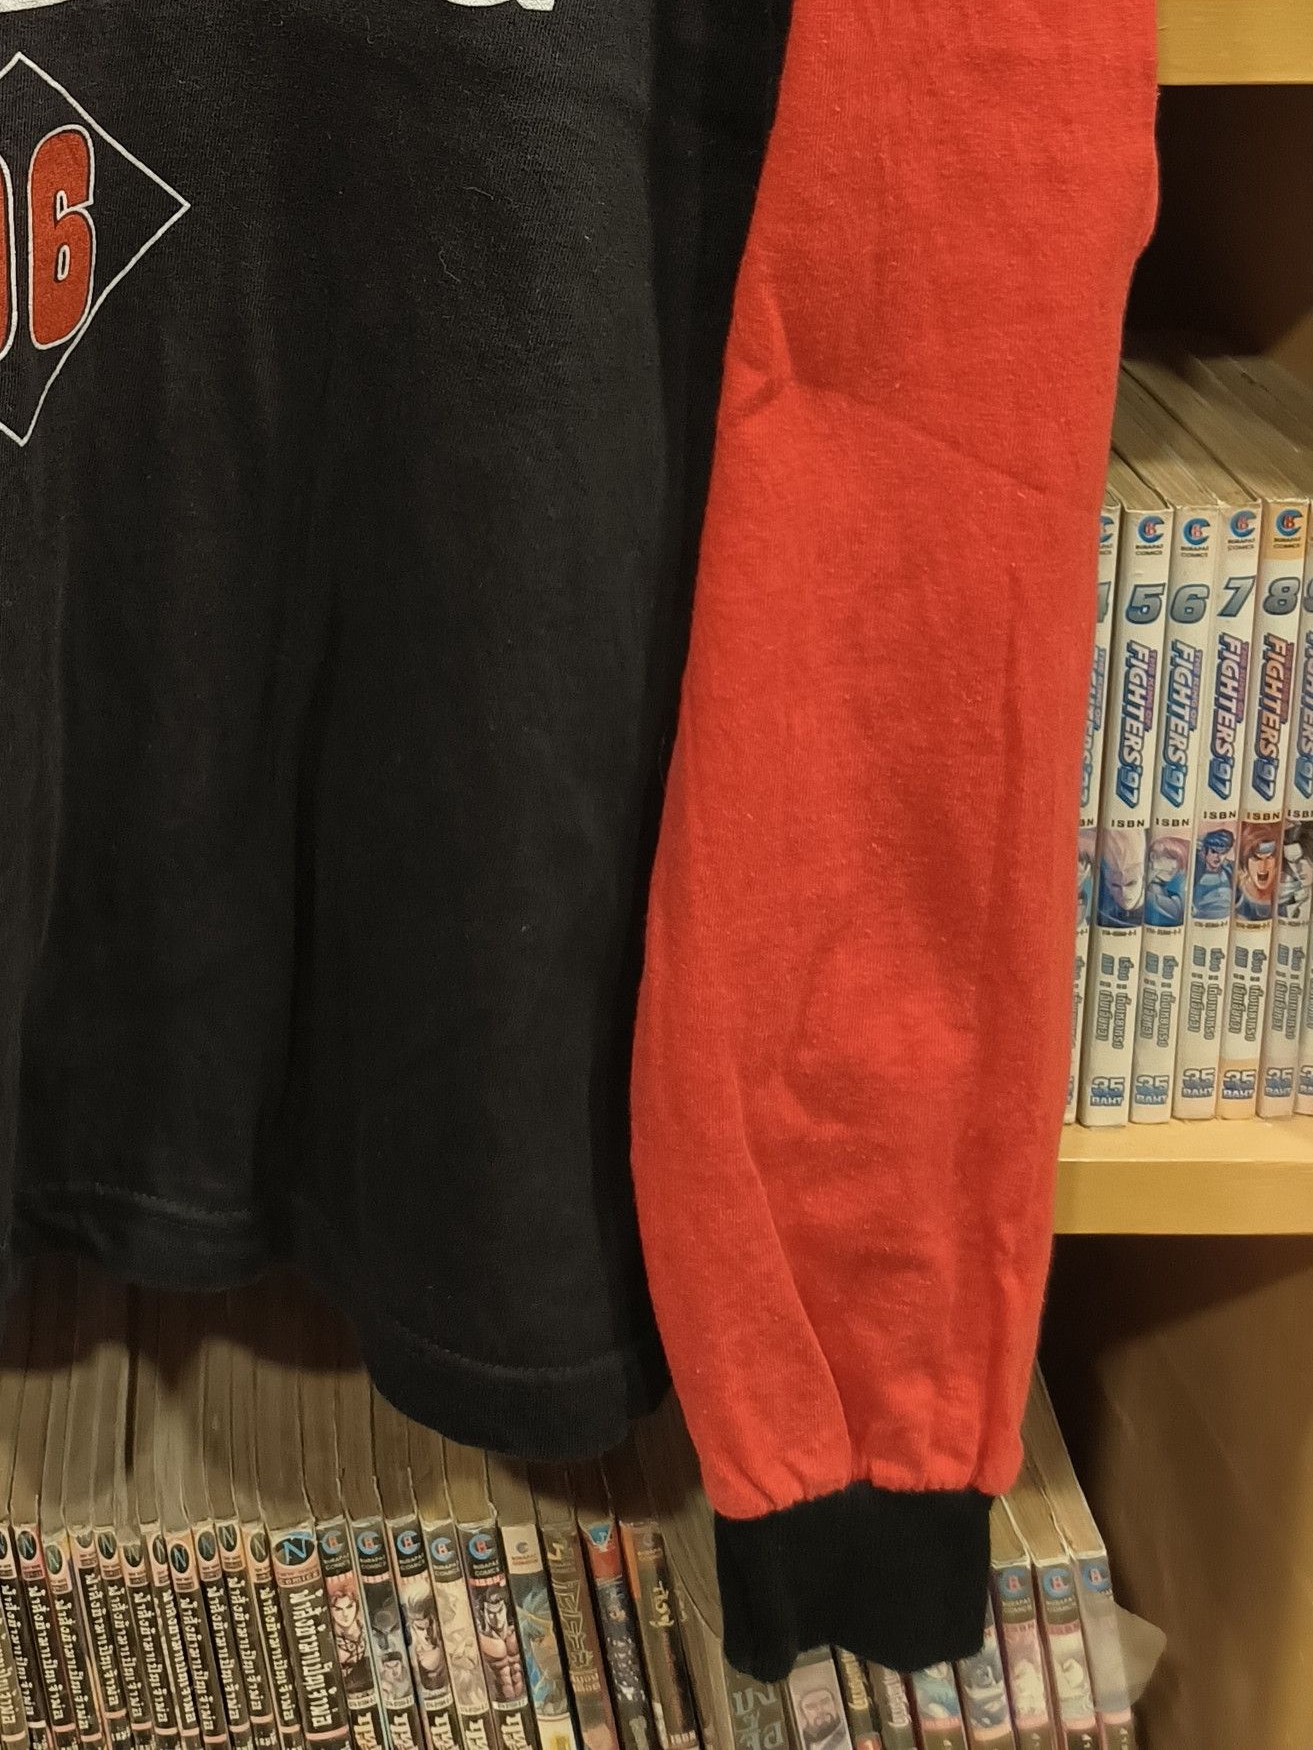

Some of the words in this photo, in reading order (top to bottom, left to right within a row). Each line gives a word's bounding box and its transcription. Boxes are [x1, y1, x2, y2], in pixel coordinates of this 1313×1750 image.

[1125, 583, 1166, 624] 5
[1170, 584, 1210, 624] 6
[1217, 576, 1256, 617] 7
[1263, 577, 1300, 615] 8
[1119, 640, 1152, 761] FIGHTERS
[1163, 639, 1196, 760] FIGHTERS
[1210, 632, 1245, 754] FIGHTERS
[1255, 633, 1289, 754] FIGHTERS
[1111, 819, 1144, 828] ISBN
[1156, 818, 1189, 827] ISBN
[1203, 811, 1236, 820] ISBN
[1246, 812, 1279, 820] ISBN
[1136, 1075, 1169, 1091] 35
[1182, 1068, 1215, 1084] 35
[1223, 1069, 1256, 1085] 35
[1091, 1077, 1124, 1095] 35
[1090, 1095, 1123, 1106] BAHT
[1135, 1093, 1167, 1104] BAHT
